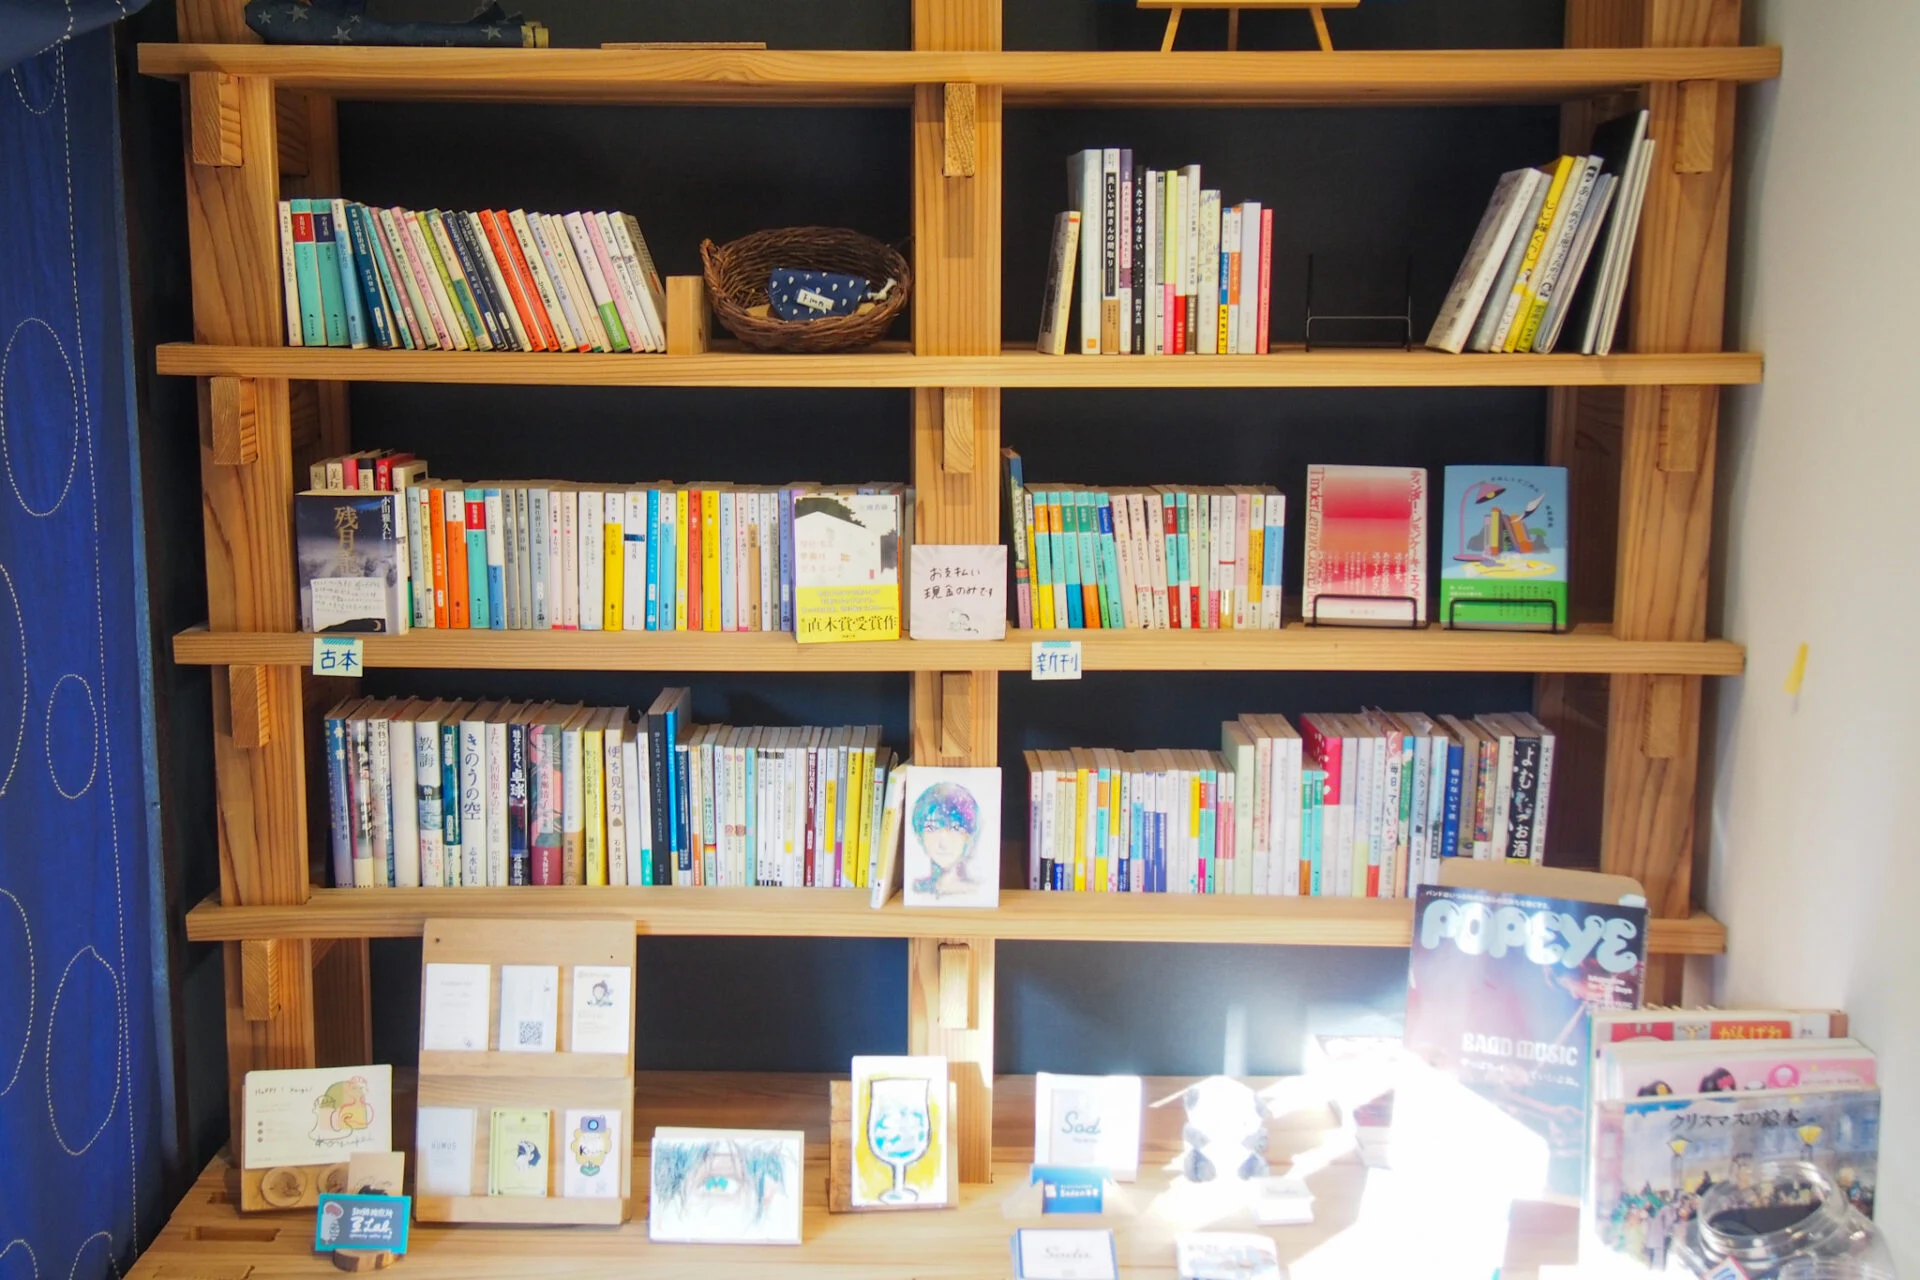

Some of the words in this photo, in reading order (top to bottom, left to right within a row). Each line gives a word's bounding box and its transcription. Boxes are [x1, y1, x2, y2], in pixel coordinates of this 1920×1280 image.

[333, 505, 360, 576] 残月記
[923, 585, 993, 599] 現金のみです
[929, 567, 981, 581] お支払い
[320, 648, 359, 671] 古本
[1036, 652, 1078, 675] 新刊
[464, 733, 481, 821] きのうの空
[608, 746, 622, 815] 便を見る力
[1511, 743, 1537, 858] よむお酒
[1420, 899, 1638, 973] POPEYE
[1669, 1107, 1801, 1132] クリスマスの絵本
